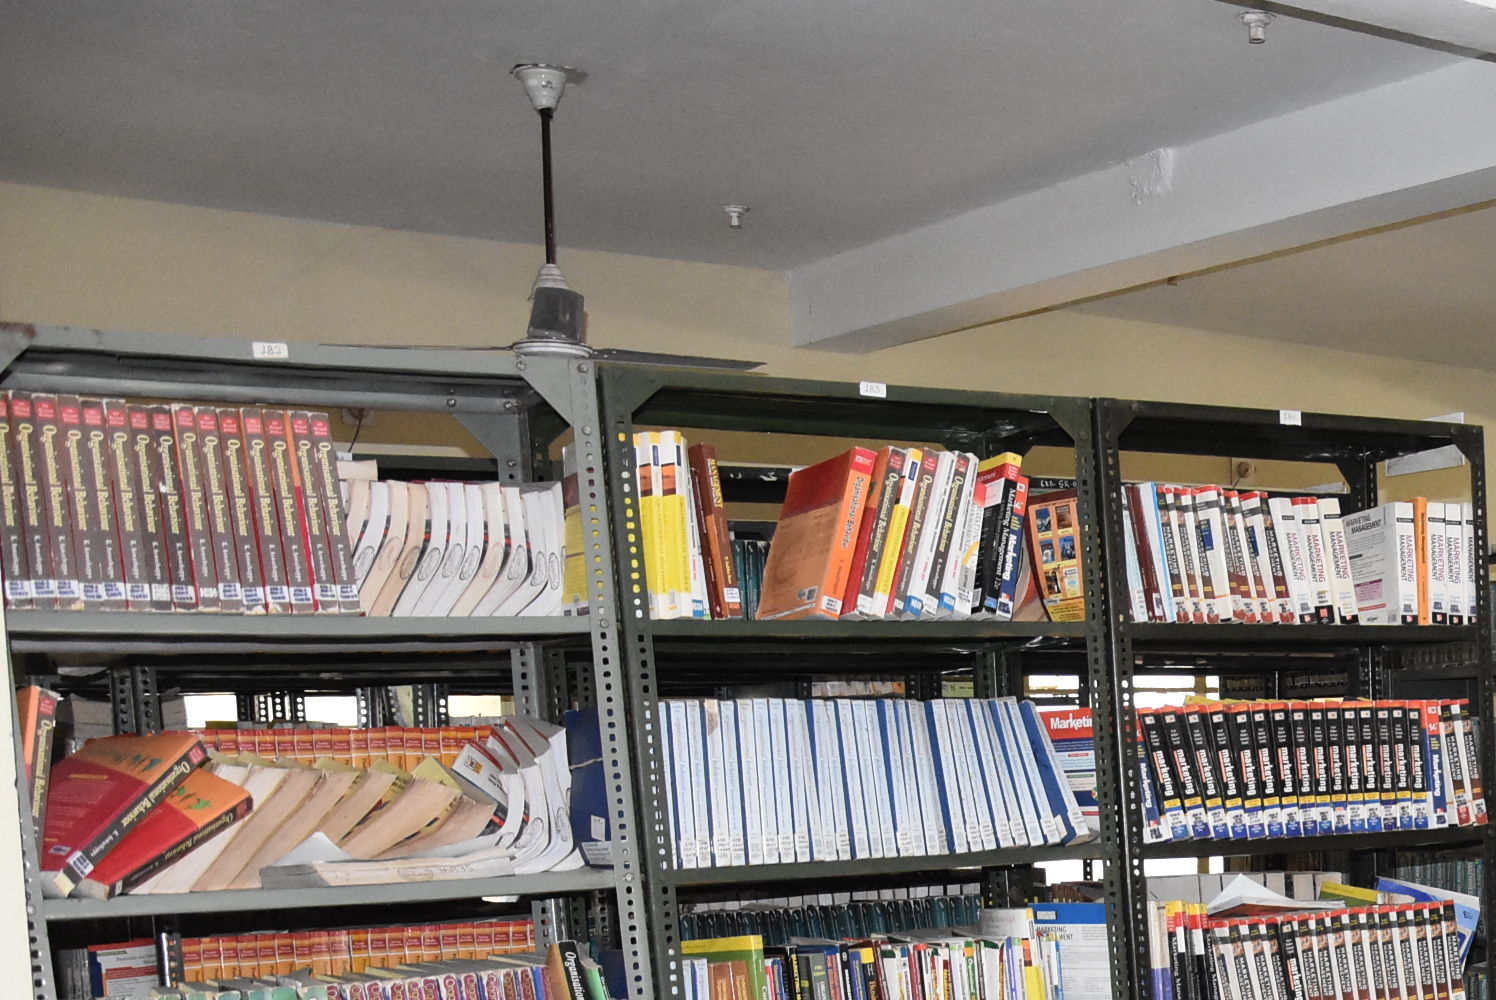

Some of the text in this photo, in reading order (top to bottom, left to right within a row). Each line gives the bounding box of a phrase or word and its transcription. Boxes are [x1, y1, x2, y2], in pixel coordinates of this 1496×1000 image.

[260, 345, 282, 355] 182
[1002, 488, 1016, 528] Marketing
[1345, 514, 1371, 528] MARKETING
[1351, 519, 1382, 534] MANAGEMENT
[996, 528, 1010, 572] Management
[1003, 534, 1018, 581] Marketing
[1166, 526, 1178, 574] MARKETING
[1270, 530, 1282, 576] MARKETING
[1306, 535, 1318, 582] MANAGEMENT
[1312, 535, 1326, 583] MARKETING
[1329, 532, 1342, 579] MANAGEMENT
[1336, 531, 1350, 579] MARKETING
[1400, 534, 1408, 582] MANAGEMENT
[1406, 534, 1414, 582] MARKETING
[1468, 536, 1476, 583] MANAGEMENT
[1156, 750, 1174, 796] marketing
[1178, 749, 1194, 794] marketing
[1244, 750, 1256, 796] marketing
[1282, 747, 1293, 792] marketing
[1349, 746, 1360, 790] marketing
[1366, 744, 1376, 788] marketing
[1432, 754, 1440, 796] Marketing
[1450, 736, 1462, 780] MARKETING
[121, 761, 190, 827] Organisational Behaviour
[1140, 762, 1152, 808] Marketing
[791, 954, 800, 994] MARKETING
[1388, 944, 1398, 989] MARKETING
[1452, 936, 1461, 979] MARKETING
